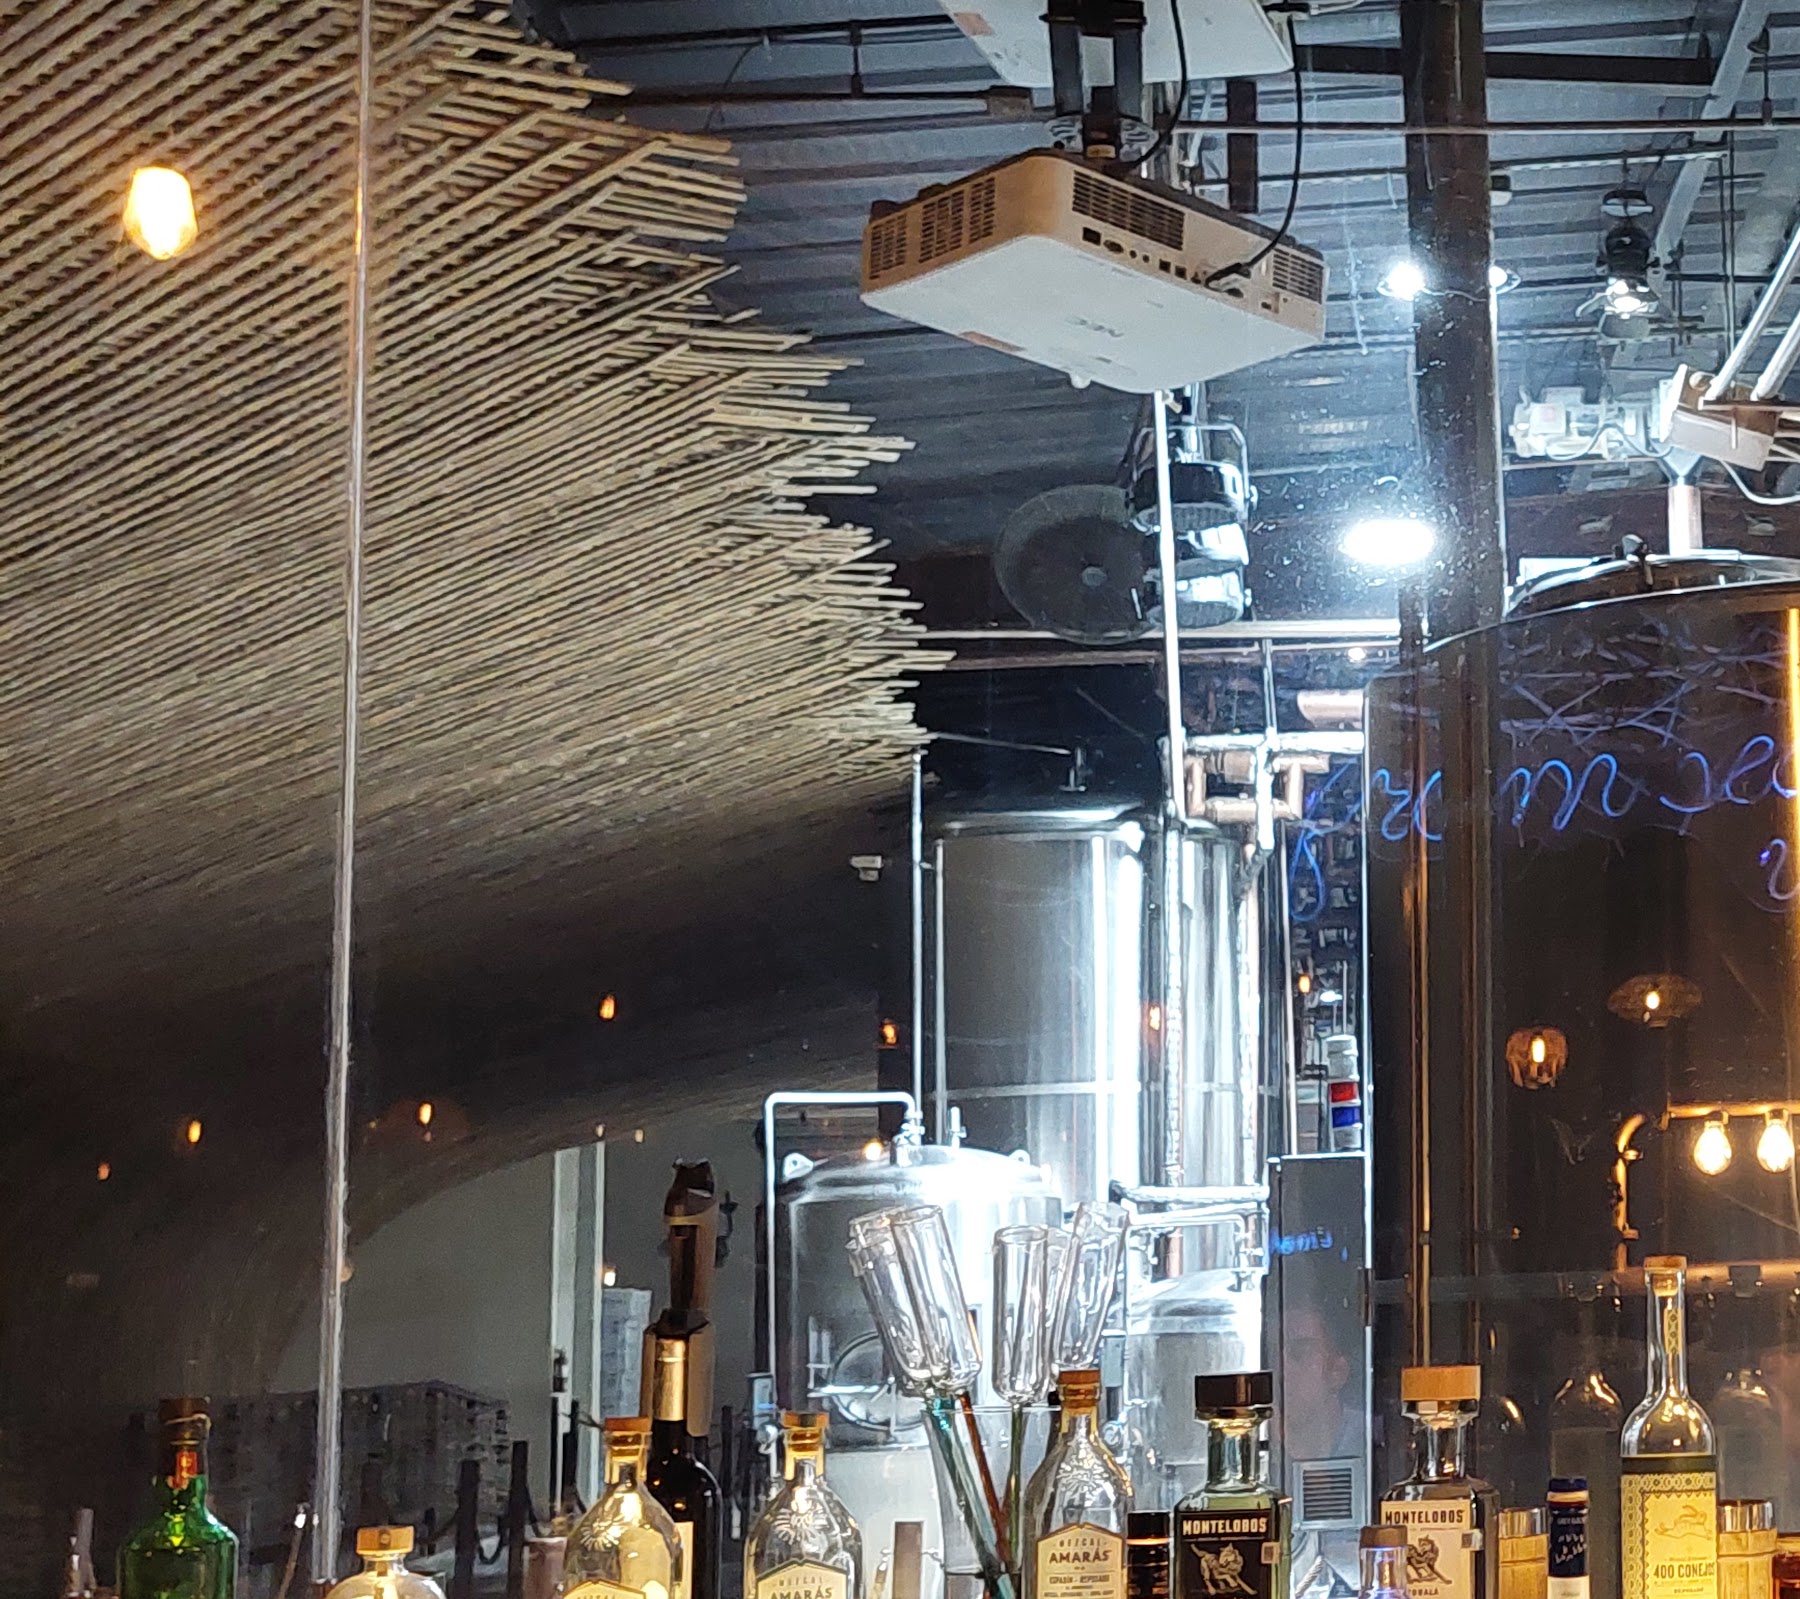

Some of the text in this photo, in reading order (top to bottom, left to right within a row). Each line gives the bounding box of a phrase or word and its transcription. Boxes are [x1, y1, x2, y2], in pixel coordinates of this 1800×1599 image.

[1385, 1509, 1465, 1525] MONTELOBOS
[1182, 1517, 1269, 1536] MONTELOBOS
[1048, 1547, 1111, 1564] AMARÁS
[1653, 1561, 1716, 1579] 400 CONEJOS
